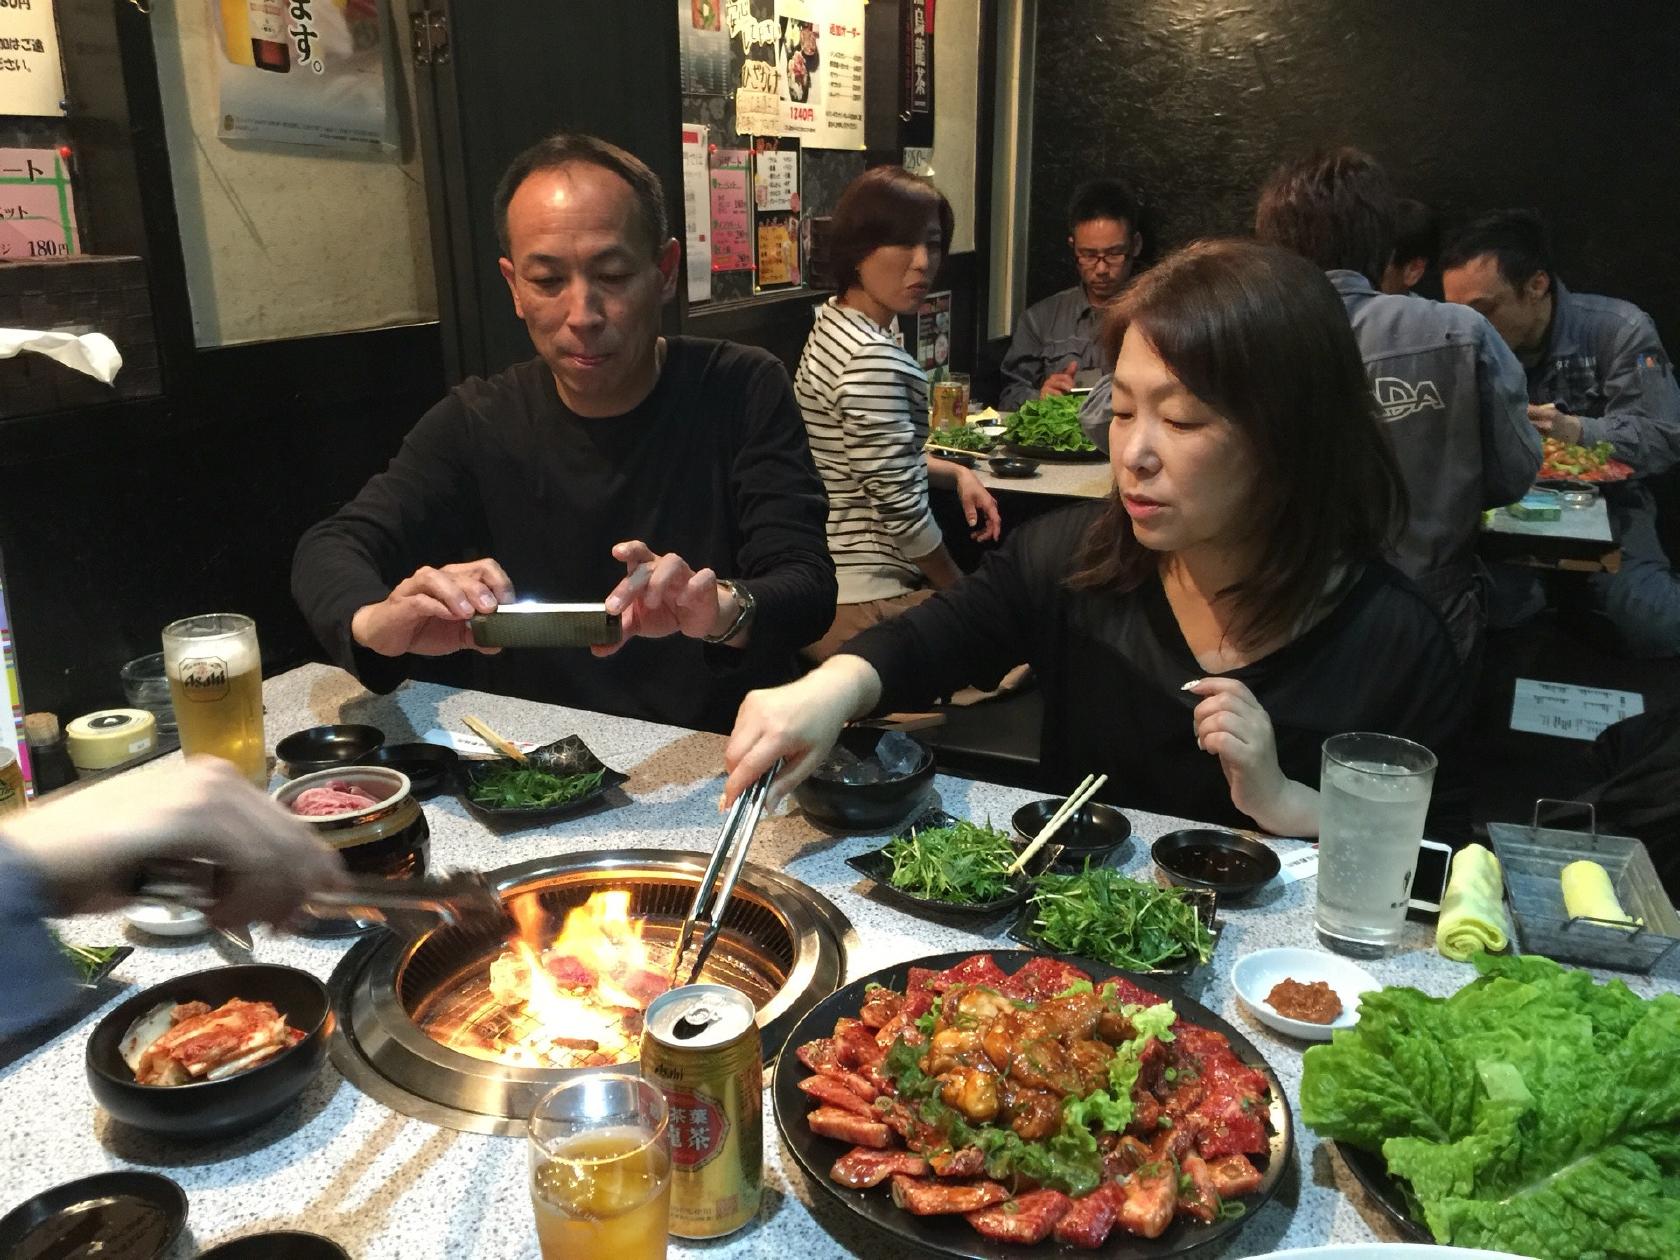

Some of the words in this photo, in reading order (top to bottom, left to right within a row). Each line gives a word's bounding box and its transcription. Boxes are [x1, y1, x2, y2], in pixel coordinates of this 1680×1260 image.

[790, 107, 813, 122] 1240円
[28, 241, 69, 257] 180円
[184, 670, 226, 688] Asahi
[655, 1063, 684, 1081] Asahi
